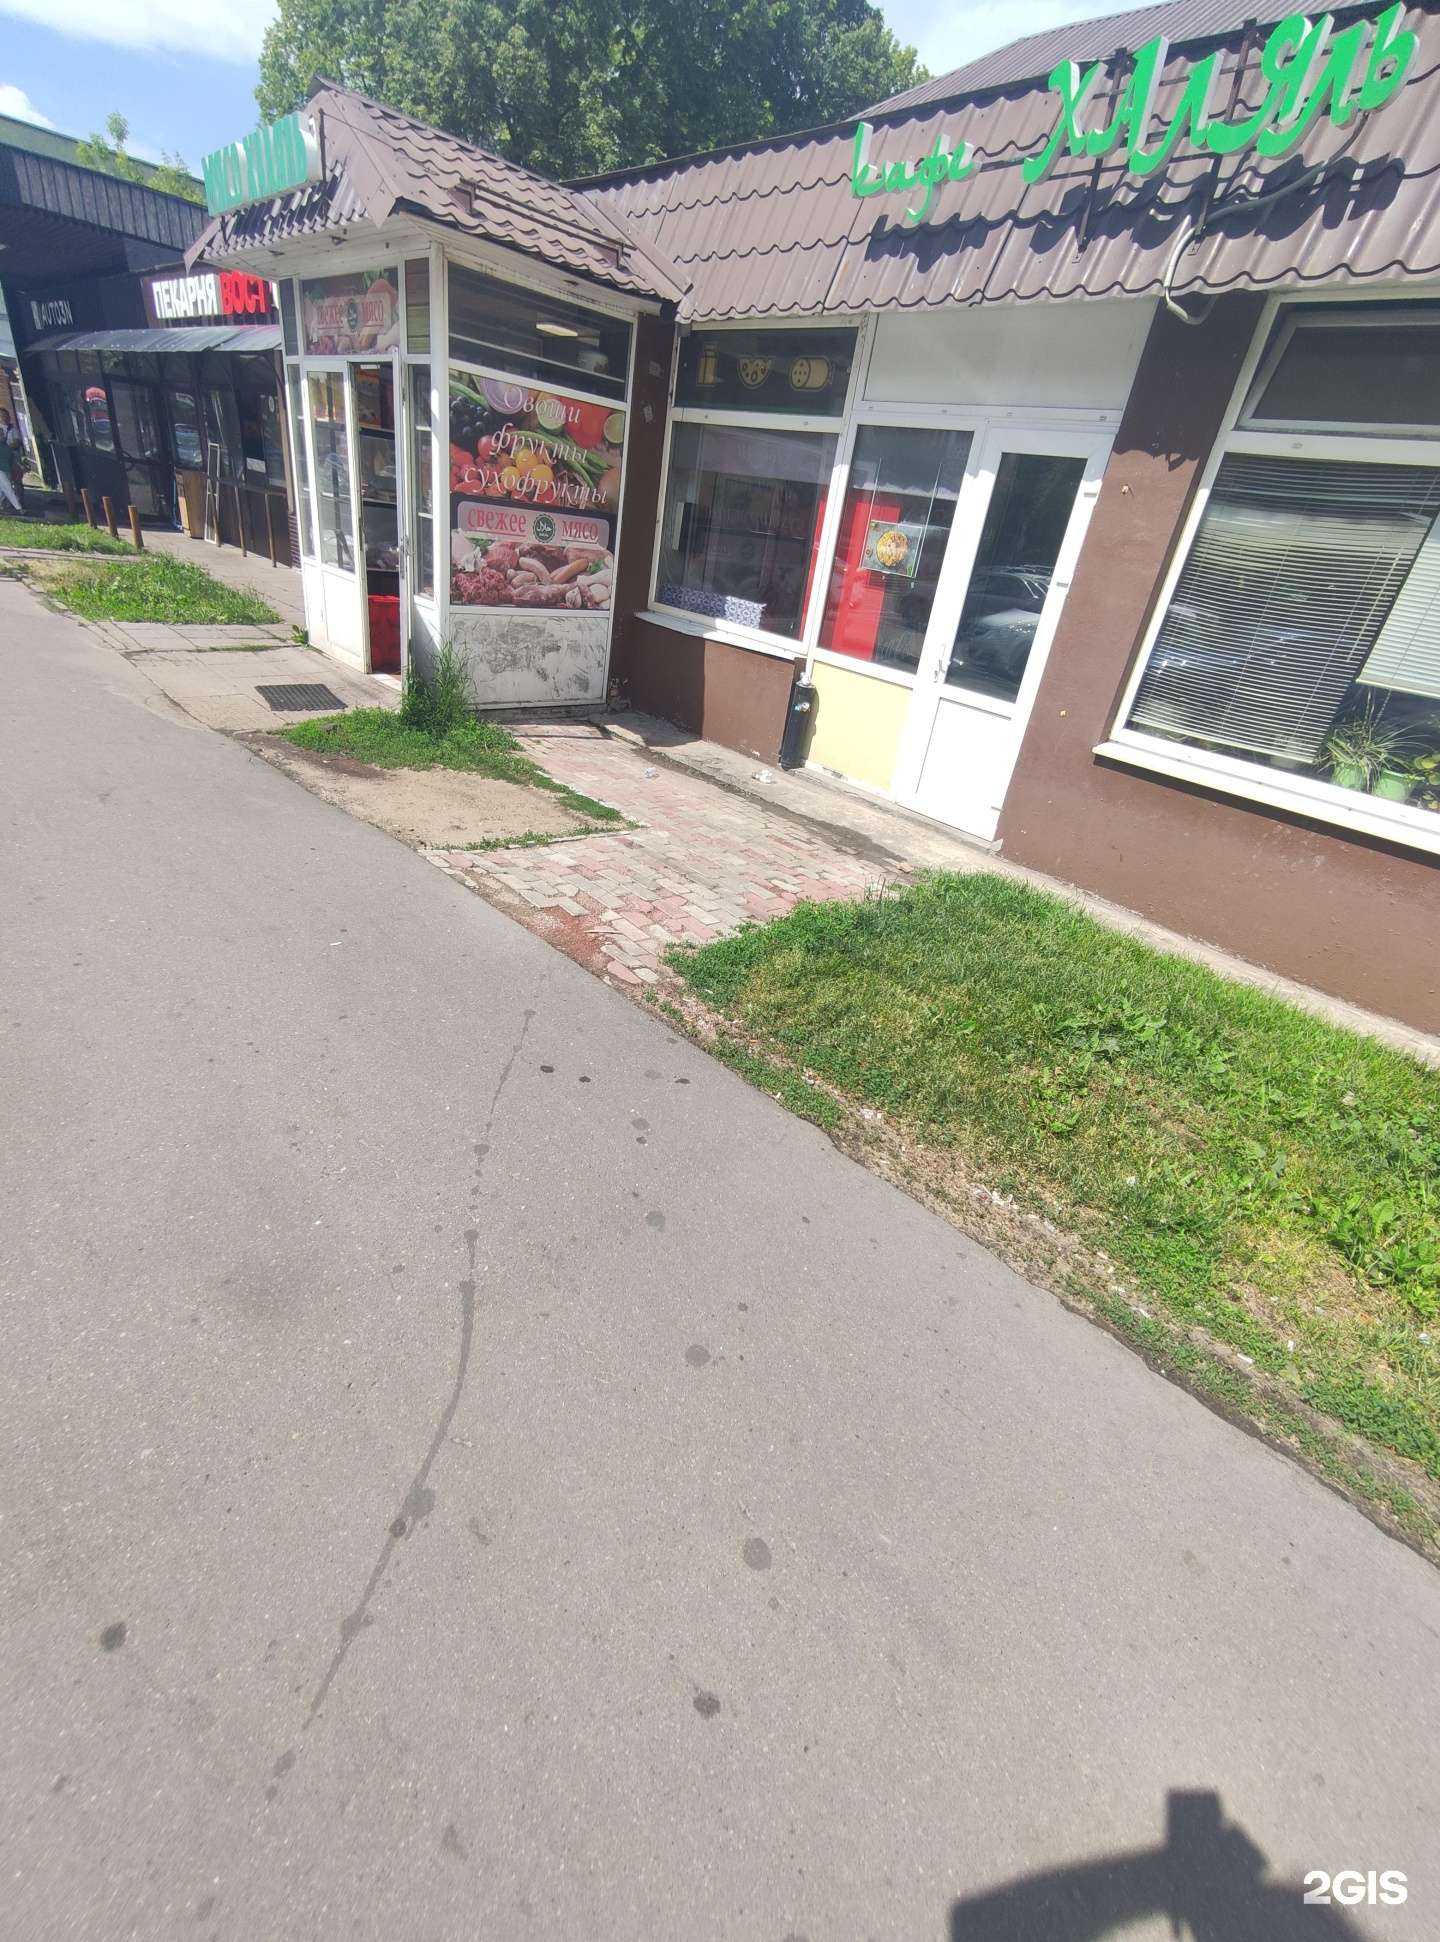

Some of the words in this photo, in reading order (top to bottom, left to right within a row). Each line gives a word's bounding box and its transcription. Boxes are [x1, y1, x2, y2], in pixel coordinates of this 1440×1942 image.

[152, 273, 218, 318] ПЕКАРНЯ
[503, 385, 582, 424] Овощи
[489, 422, 588, 465] фрукты
[464, 466, 608, 508] сухофрукты
